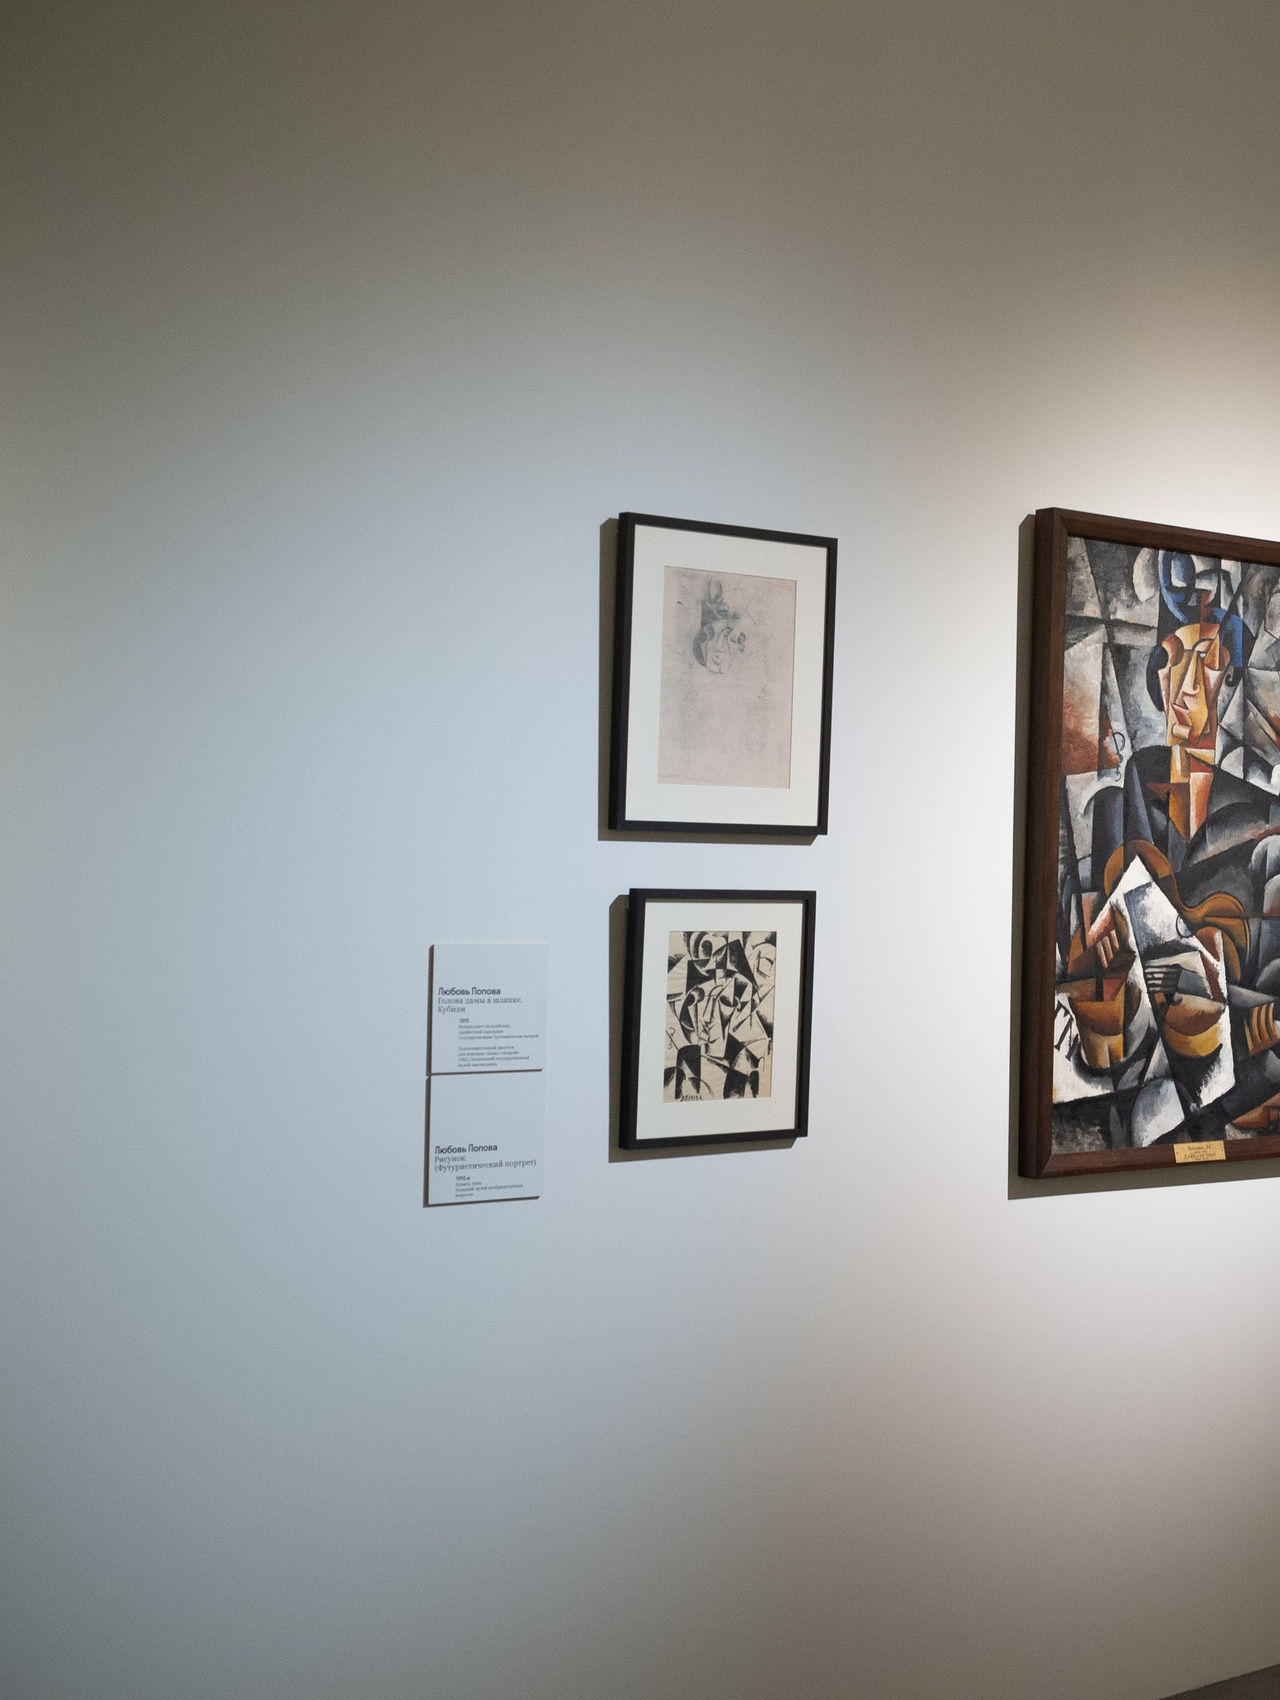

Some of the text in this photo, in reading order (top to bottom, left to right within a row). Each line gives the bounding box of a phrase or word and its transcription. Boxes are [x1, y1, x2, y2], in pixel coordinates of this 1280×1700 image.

[438, 986, 501, 996] Любовь Попова
[438, 997, 464, 1005] Голова
[438, 1006, 466, 1015] Кубизм
[434, 1143, 498, 1154] Любовь Попова
[434, 1156, 466, 1164] Рисунок
